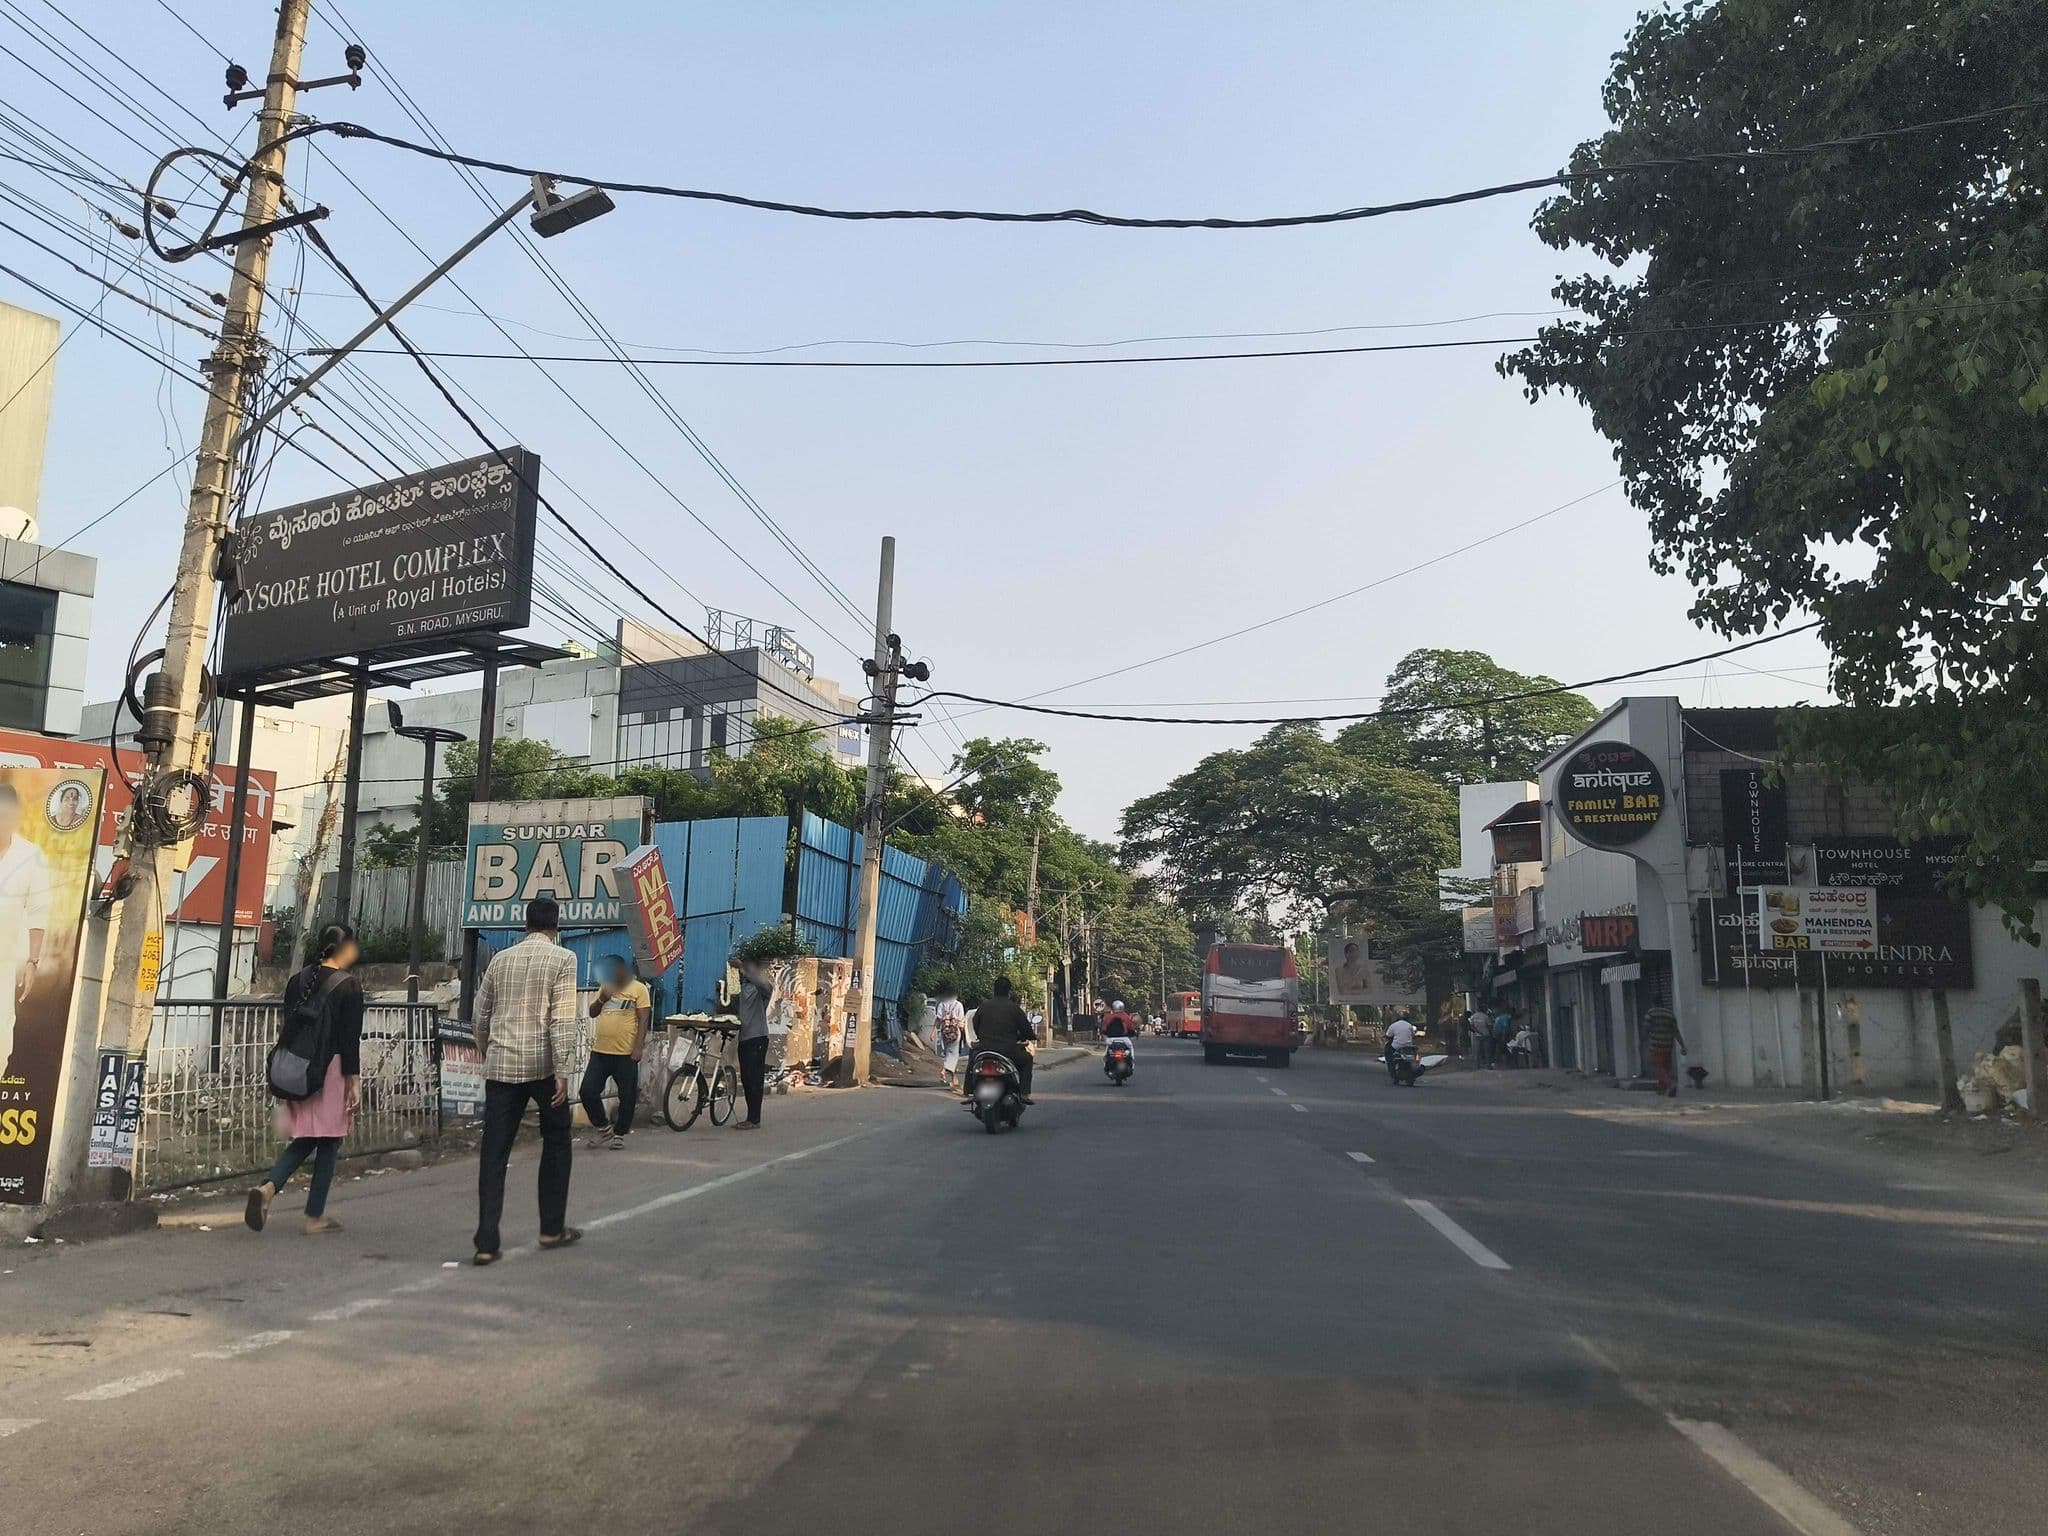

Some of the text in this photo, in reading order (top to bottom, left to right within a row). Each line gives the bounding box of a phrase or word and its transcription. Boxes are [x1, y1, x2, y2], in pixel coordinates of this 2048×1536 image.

[268, 502, 341, 550] ಮೈಸೂರು
[316, 560, 386, 598] HOTEL
[393, 532, 507, 582] COMPLEX
[348, 603, 367, 617] Unit
[370, 600, 381, 613] of
[386, 580, 436, 610] Royal
[397, 607, 504, 636] B.N. ROAD, MYSURU.
[1572, 767, 1652, 793] antique
[1568, 794, 1661, 811] FAMILY BAR
[1748, 772, 1761, 853] TOWNHOUSE
[1584, 812, 1658, 823] RESTAURANT
[502, 823, 606, 842] SUNDAR
[1818, 849, 1911, 860] TOWNHOUSE
[472, 839, 629, 902] BAR
[467, 904, 505, 922] AND
[638, 864, 675, 968] MRP
[1804, 917, 1873, 928] MAHENDRA
[1584, 919, 1633, 947] MRP
[1775, 936, 1809, 949] BAR
[1847, 966, 1935, 975] HOTELS
[100, 1056, 118, 1108] IAS
[124, 1064, 140, 1115] IAS
[95, 1111, 115, 1125] IPS
[120, 1118, 137, 1131] IPS
